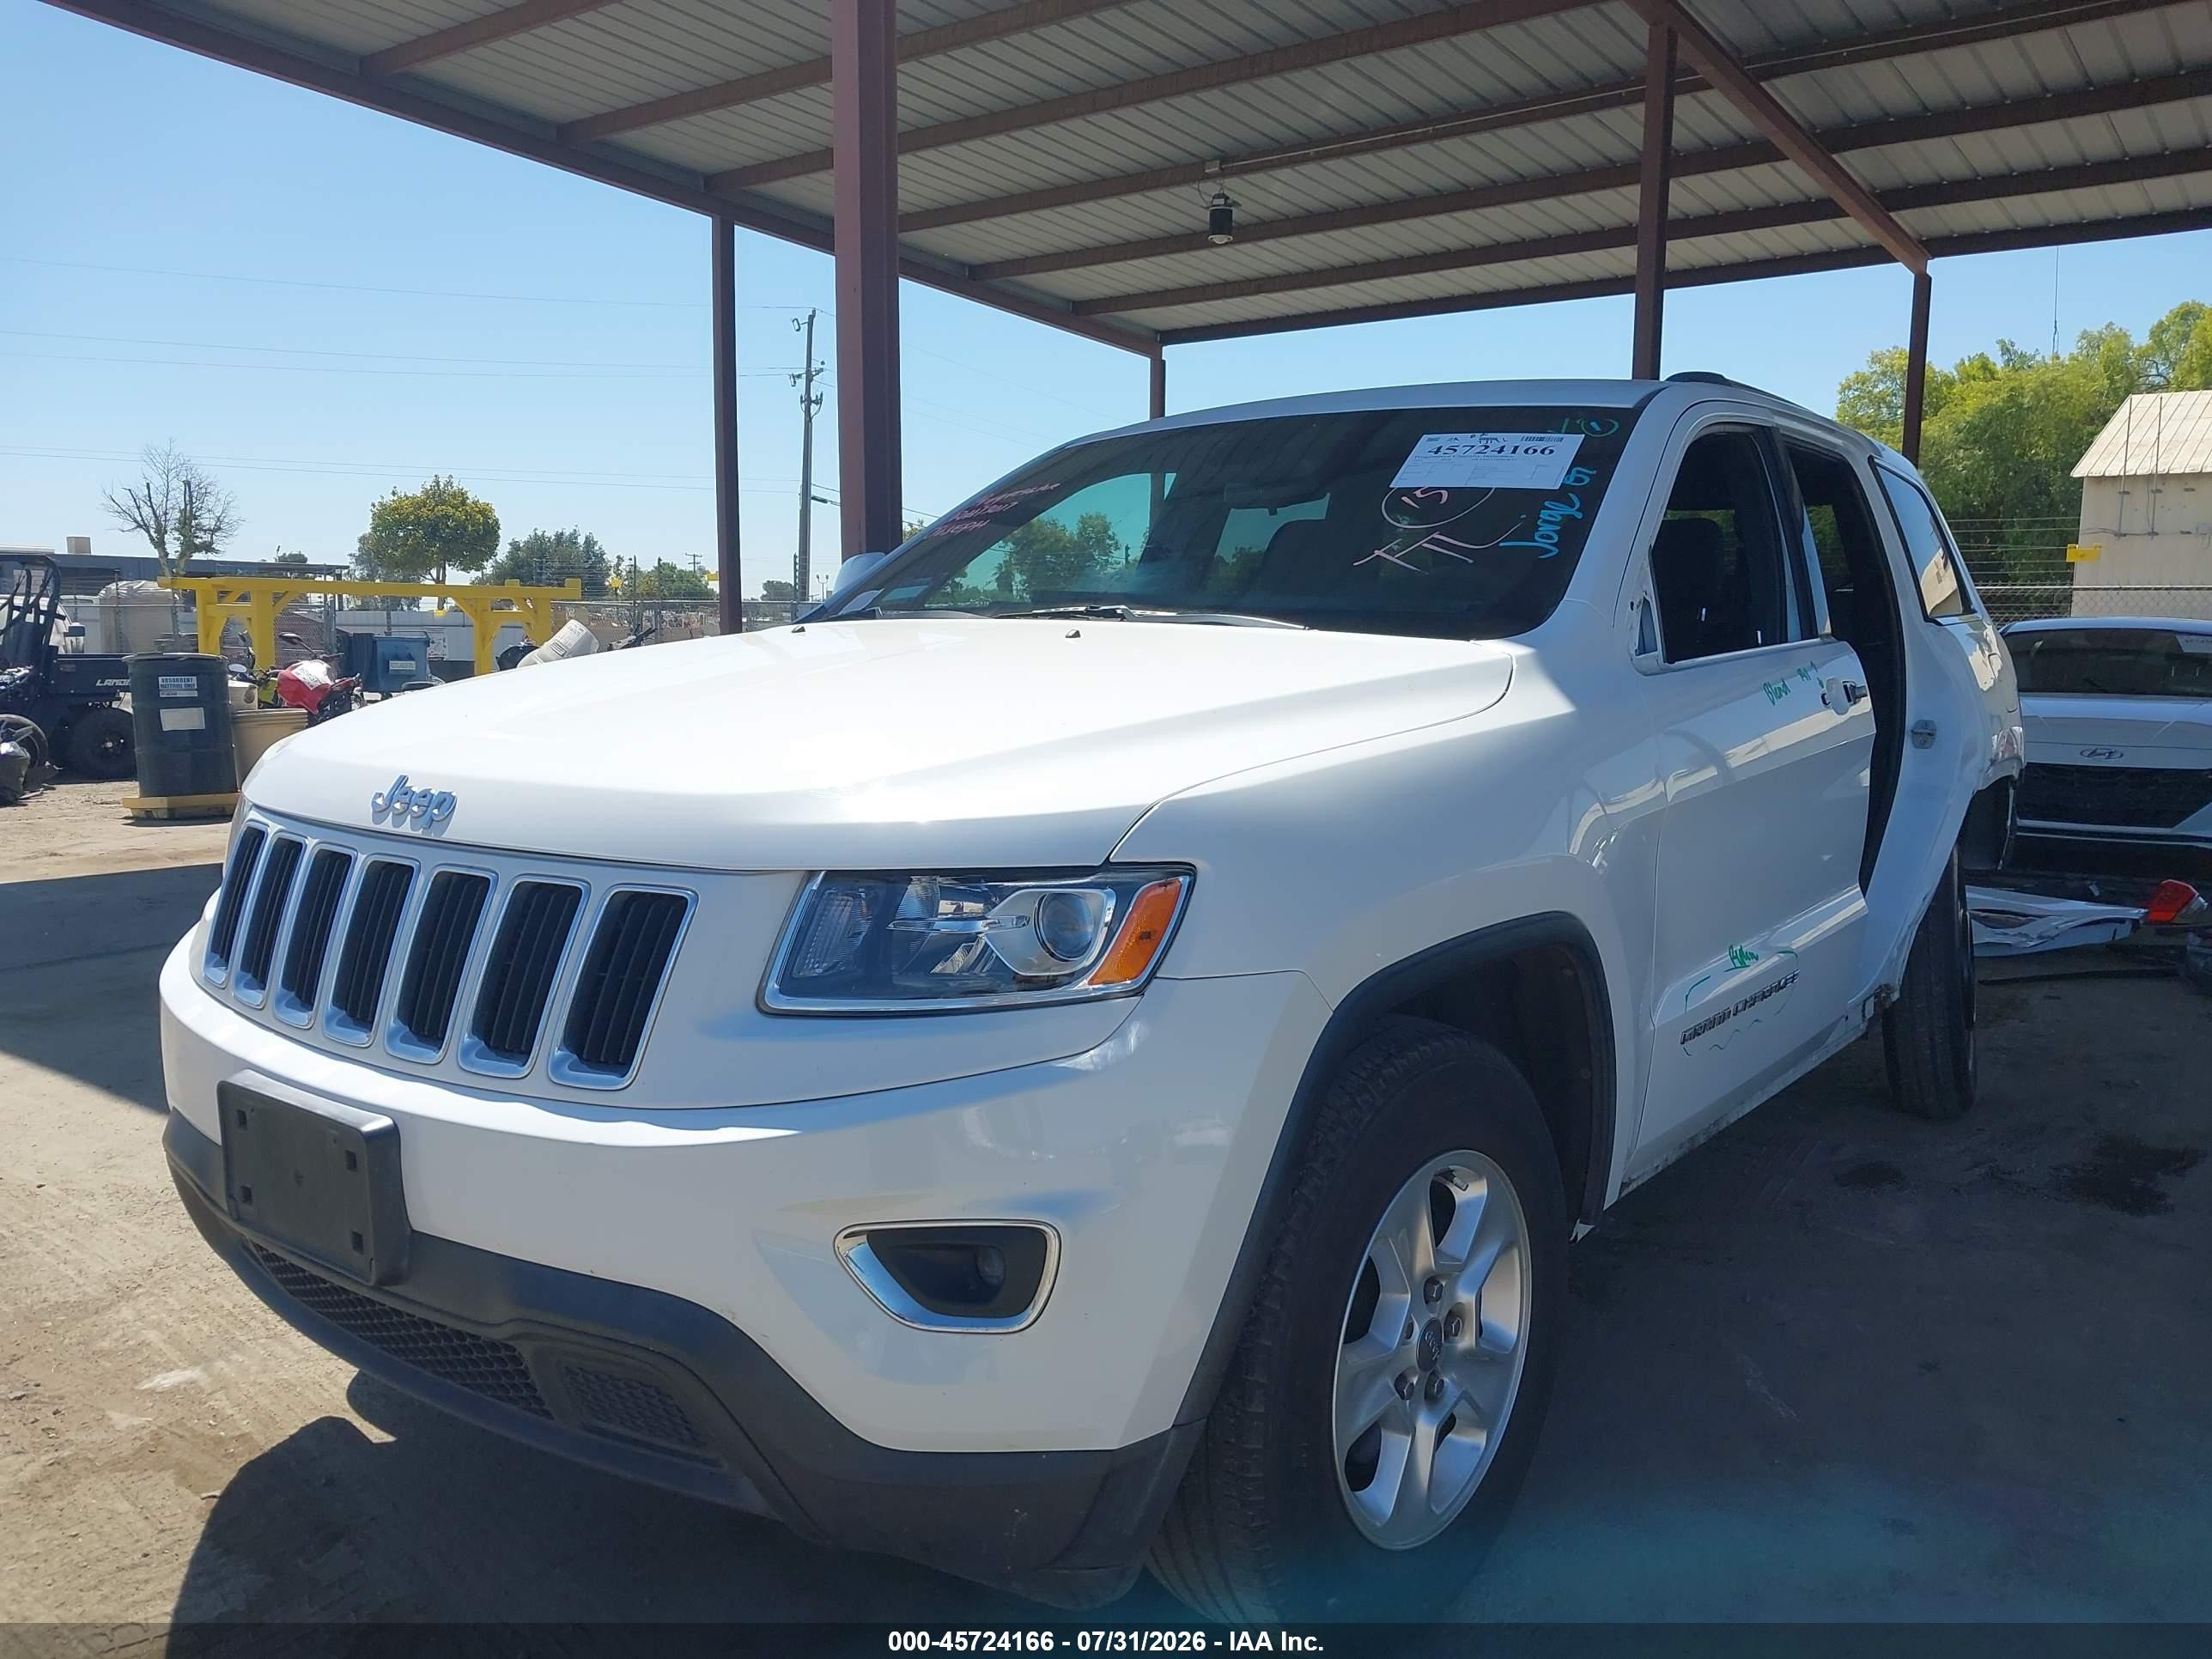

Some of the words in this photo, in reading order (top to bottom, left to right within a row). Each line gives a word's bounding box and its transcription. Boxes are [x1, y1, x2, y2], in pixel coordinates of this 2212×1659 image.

[1426, 444, 1556, 455] 45724166
[371, 774, 457, 830] Jeep
[1680, 1006, 1732, 1046] GRAND
[1732, 969, 1801, 1017] CHEROKEE
